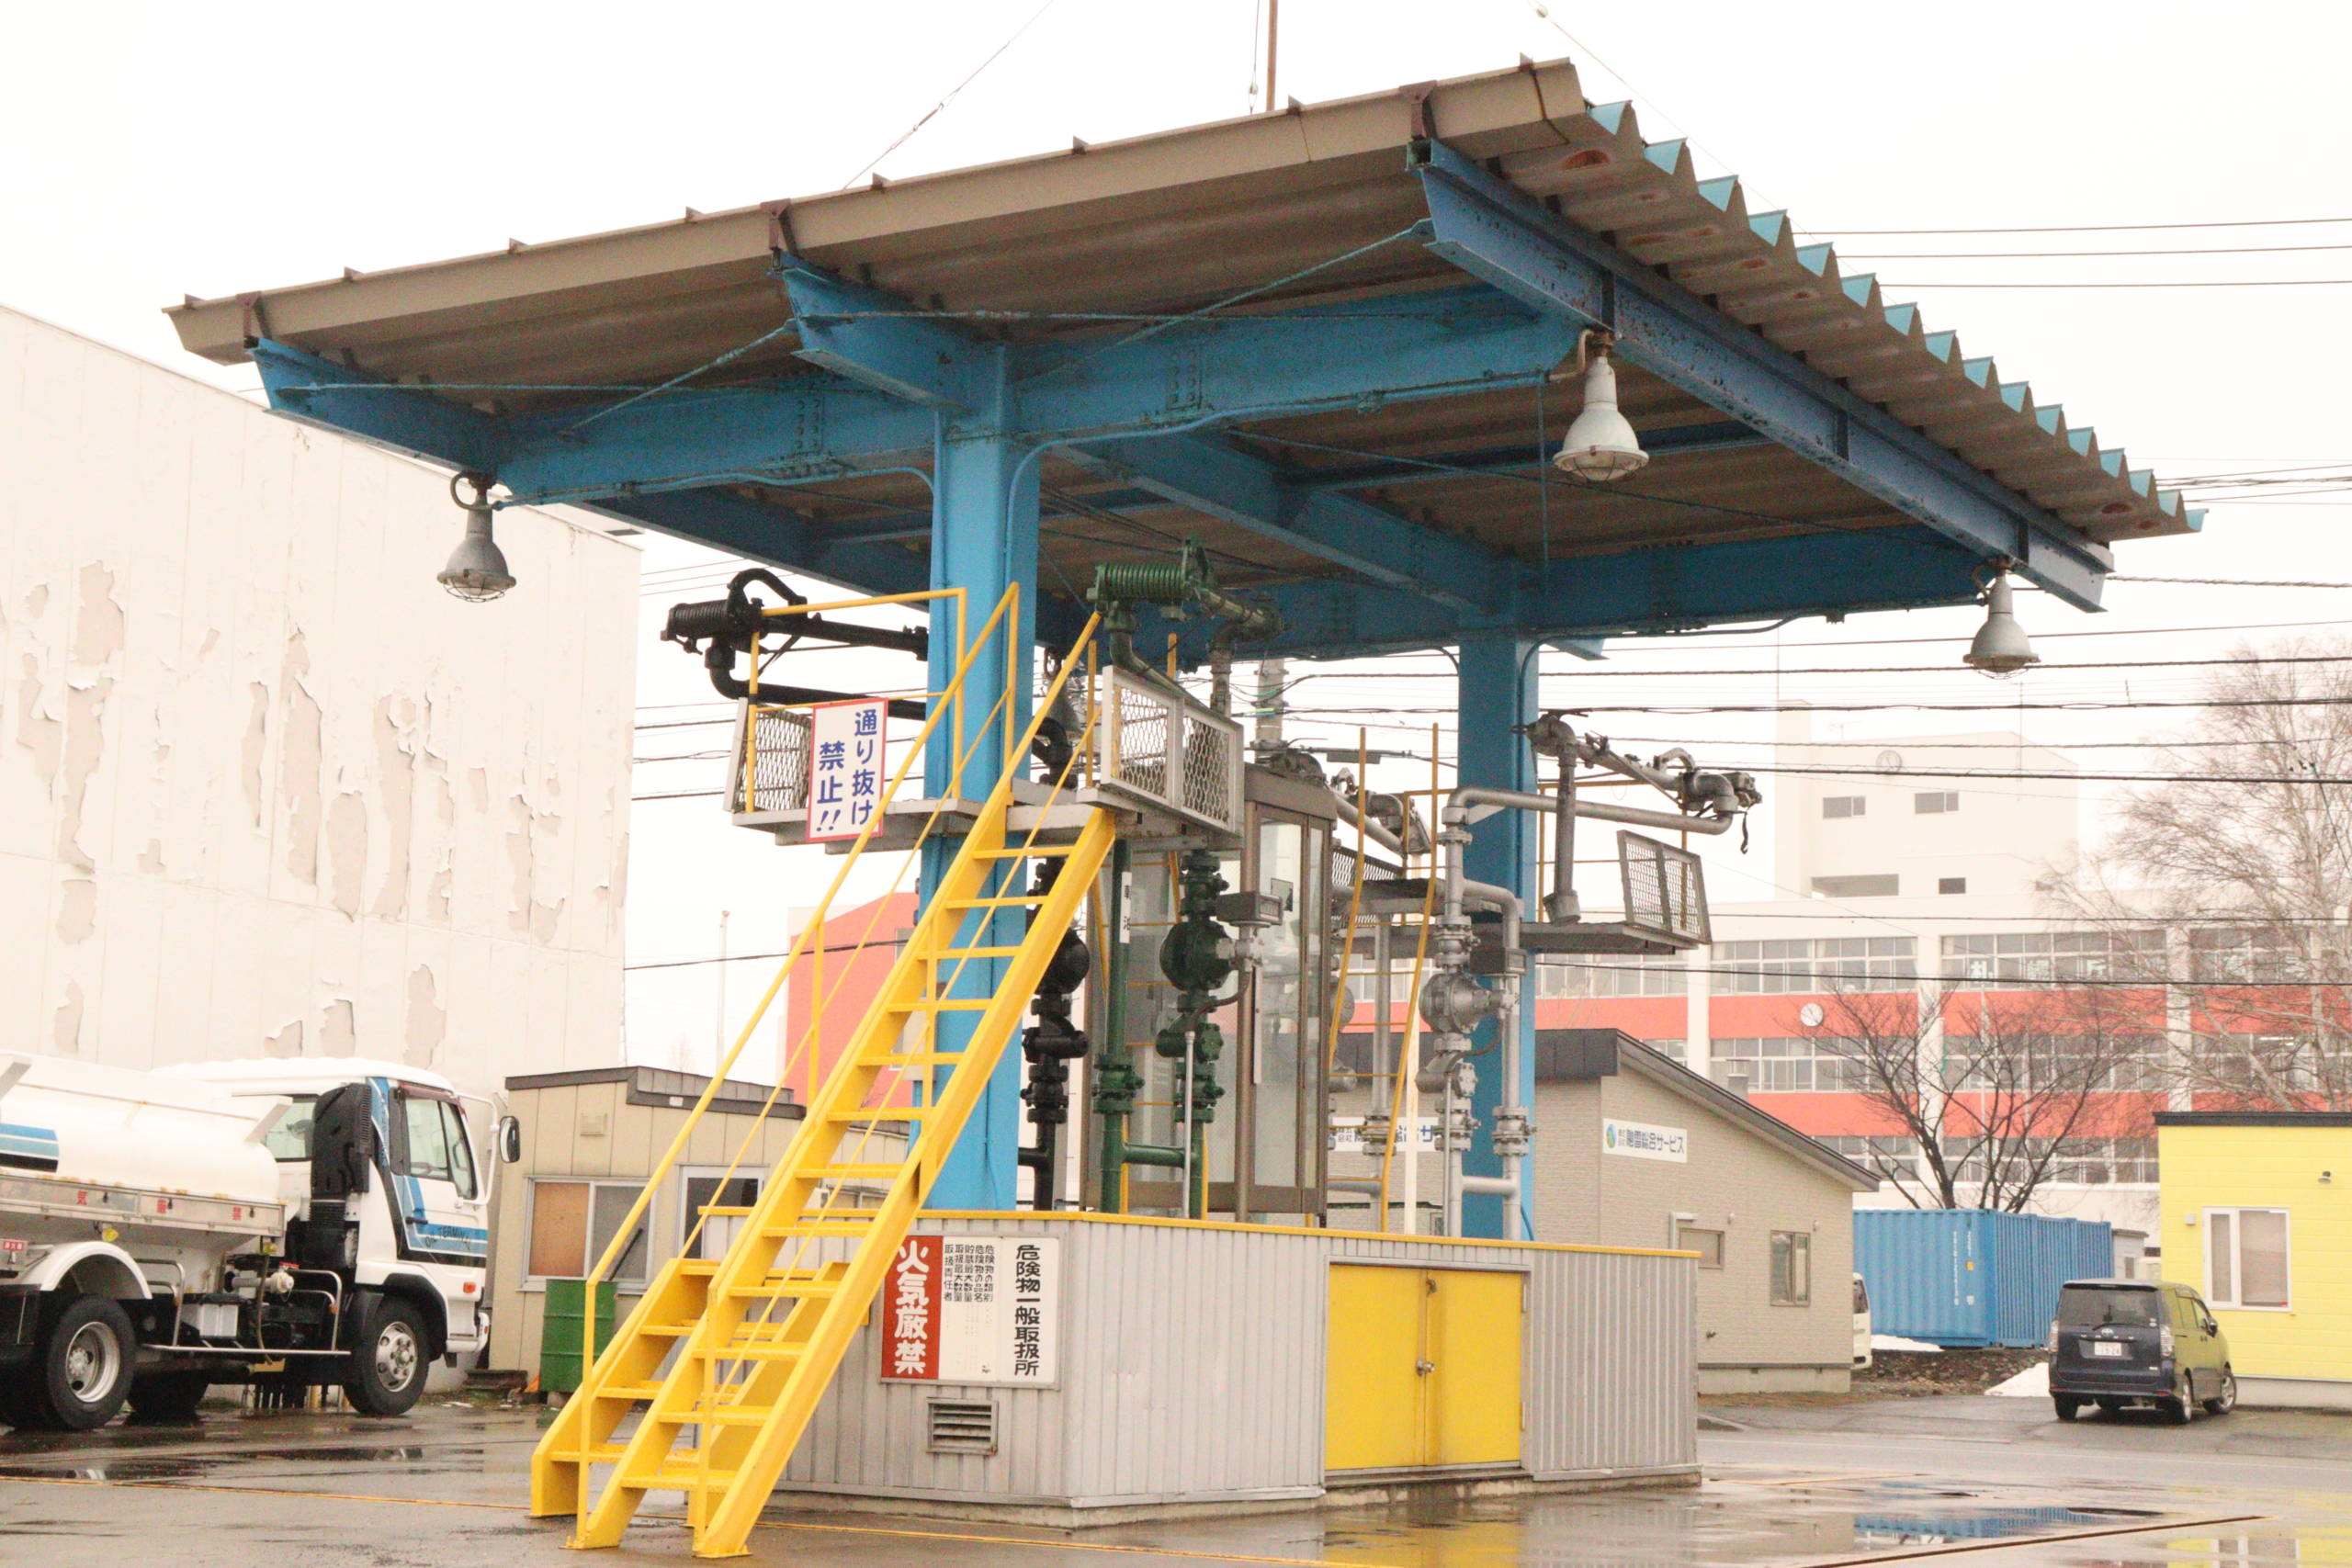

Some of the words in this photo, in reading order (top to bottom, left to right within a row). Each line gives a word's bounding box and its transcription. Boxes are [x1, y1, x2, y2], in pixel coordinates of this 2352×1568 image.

[816, 740, 845, 832] 禁止!!
[851, 708, 877, 826] 通り抜け
[424, 1231, 438, 1247] OIL
[438, 1226, 472, 1251] TERMINAL
[944, 1244, 954, 1302] 取扱責任者
[954, 1244, 965, 1303] 取扱最大数量
[964, 1244, 975, 1303] 貯蔵最大数量
[974, 1244, 985, 1303] 危険物の品名
[984, 1244, 995, 1303] 危険物の類別
[894, 1239, 930, 1375] 火気厳禁
[1014, 1245, 1041, 1377] 危険物一般取扱所
